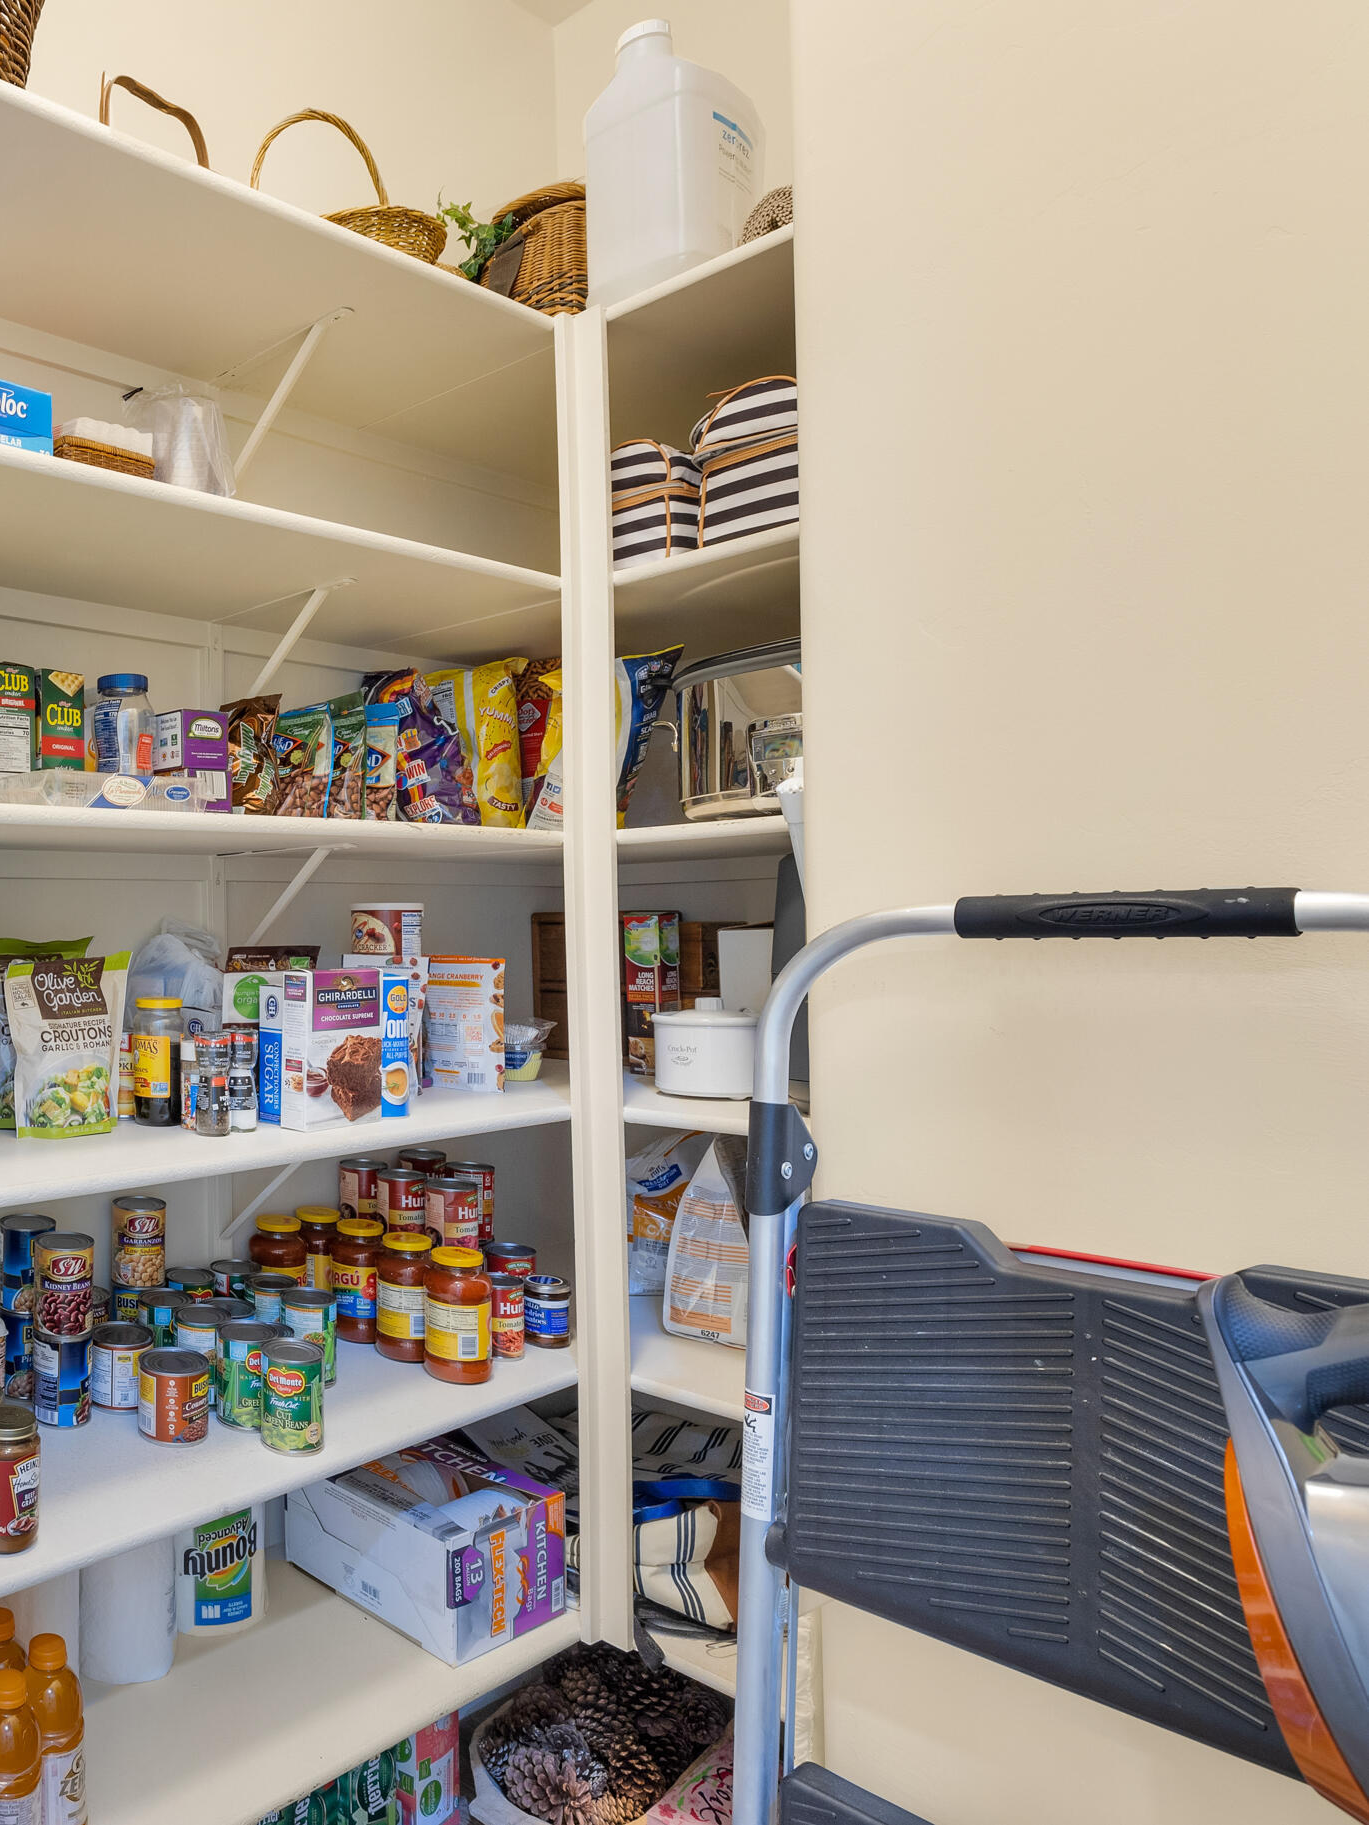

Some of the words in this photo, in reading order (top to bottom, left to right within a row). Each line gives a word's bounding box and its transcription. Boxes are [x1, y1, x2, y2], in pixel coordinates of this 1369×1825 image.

[490, 678, 511, 694] CRISPY
[1, 698, 25, 707] ORIGINAL
[46, 704, 81, 727] CLUB
[479, 707, 516, 731] YUMMY
[406, 762, 426, 780] WIN
[491, 800, 516, 811] TASTY
[1051, 904, 1171, 925] WERNER
[34, 973, 75, 991] Olive
[446, 972, 484, 981] CRANBERRY
[635, 977, 655, 986] REACH
[637, 971, 655, 979] LONG
[318, 988, 376, 1002] GHIRARDELLI
[628, 984, 655, 993] MATCHES
[44, 988, 102, 1014] Garden
[390, 993, 407, 1002] GOLD
[320, 1013, 352, 1022] CHOCOLATE
[352, 1012, 374, 1020] SUPREME
[41, 1025, 112, 1043] CROUTONS
[41, 1043, 75, 1052] GARLIC
[264, 1044, 274, 1105] SUGAR
[45, 1281, 71, 1290] KIDNEY
[700, 1328, 720, 1340] 6247
[279, 1377, 302, 1386] Monte
[264, 1412, 285, 1428] GREEN
[285, 1421, 309, 1429] BEANS
[276, 1410, 293, 1420] CUT
[198, 1516, 249, 1544] Advanced
[183, 1520, 257, 1578] Bounty
[535, 1520, 547, 1600] KITCHEN
[471, 1558, 483, 1584] 13
[490, 1528, 507, 1637] FLEX-TECH
